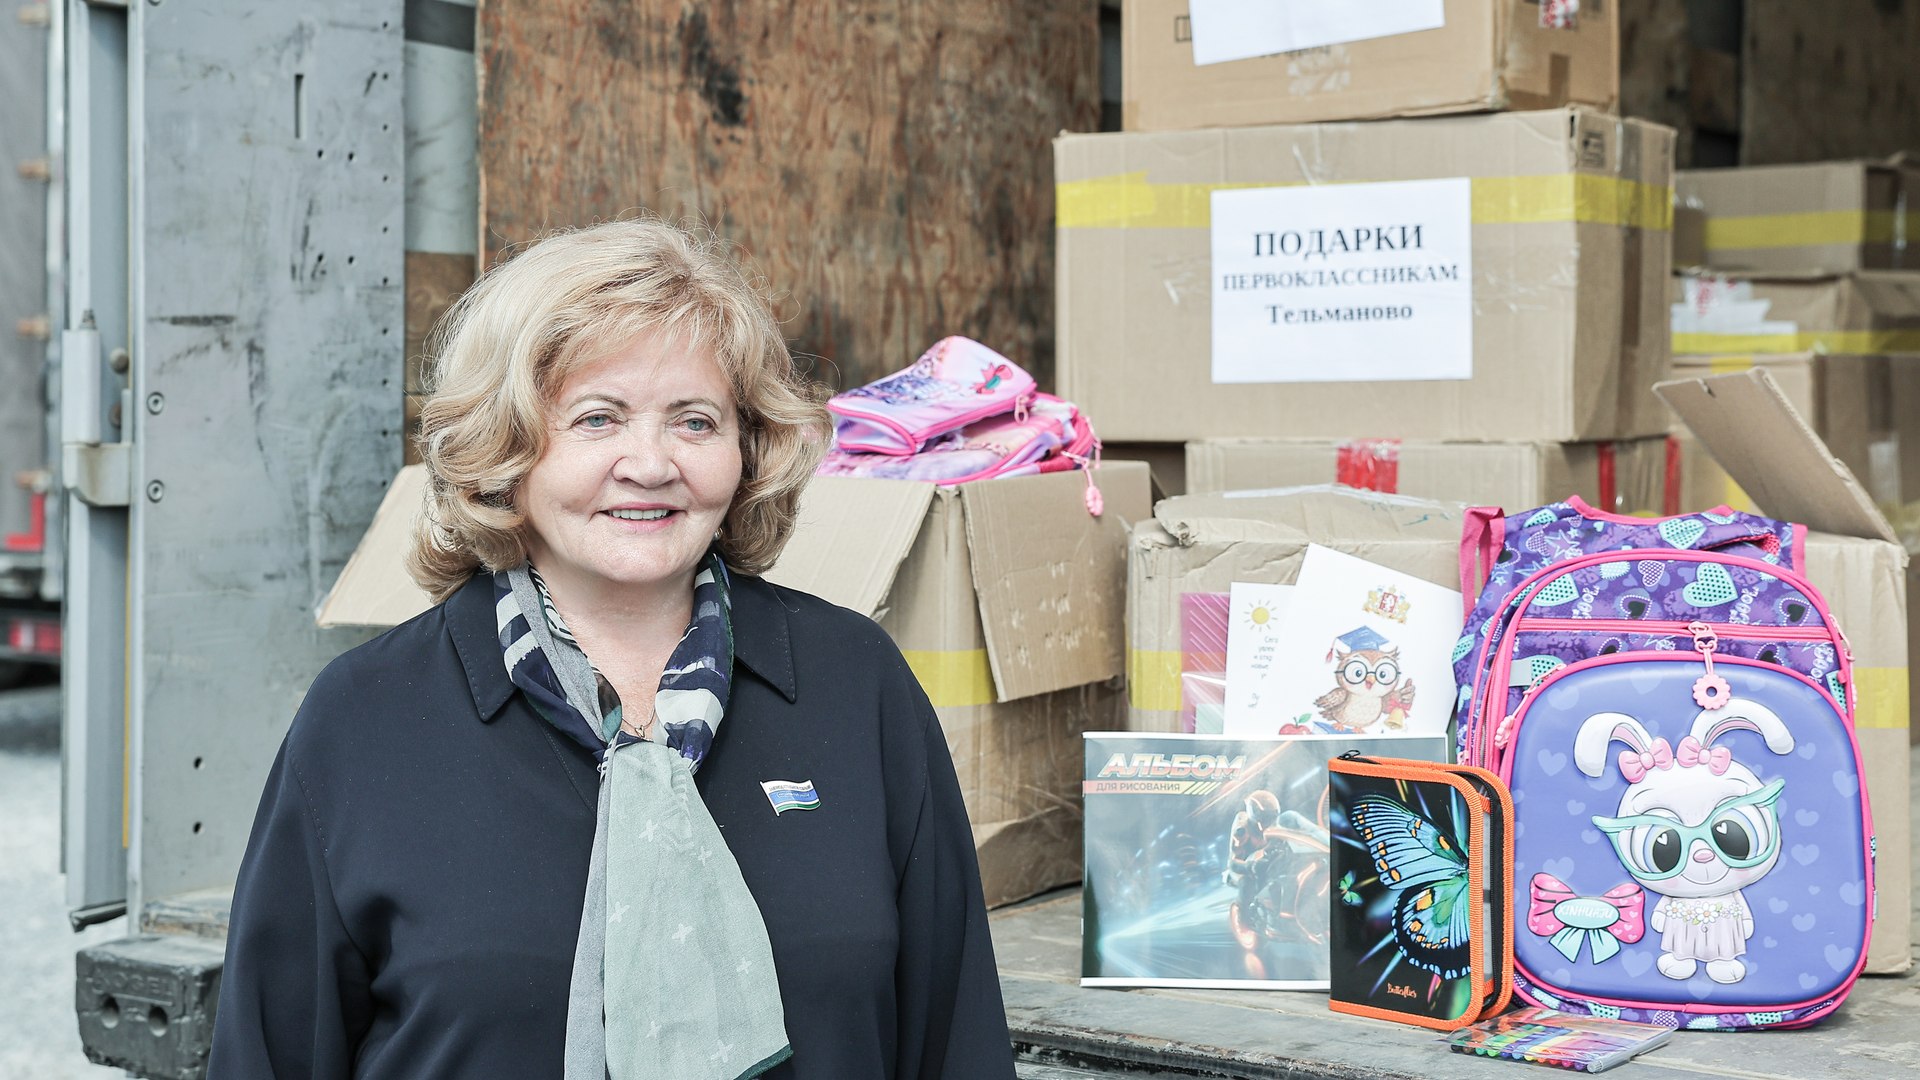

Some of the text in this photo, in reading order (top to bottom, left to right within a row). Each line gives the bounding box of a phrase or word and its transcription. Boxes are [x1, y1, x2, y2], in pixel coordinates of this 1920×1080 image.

[1252, 224, 1424, 261] ПОДАРКИ
[1222, 264, 1459, 291] ПЕРВОКЛАССНИКАМ
[1265, 303, 1414, 325] Тельманово
[1098, 753, 1247, 779] АЛЬБОМ
[1096, 783, 1181, 793] ДЛЯ РИСОВАНИЯ
[1557, 904, 1615, 920] XINHUAJU
